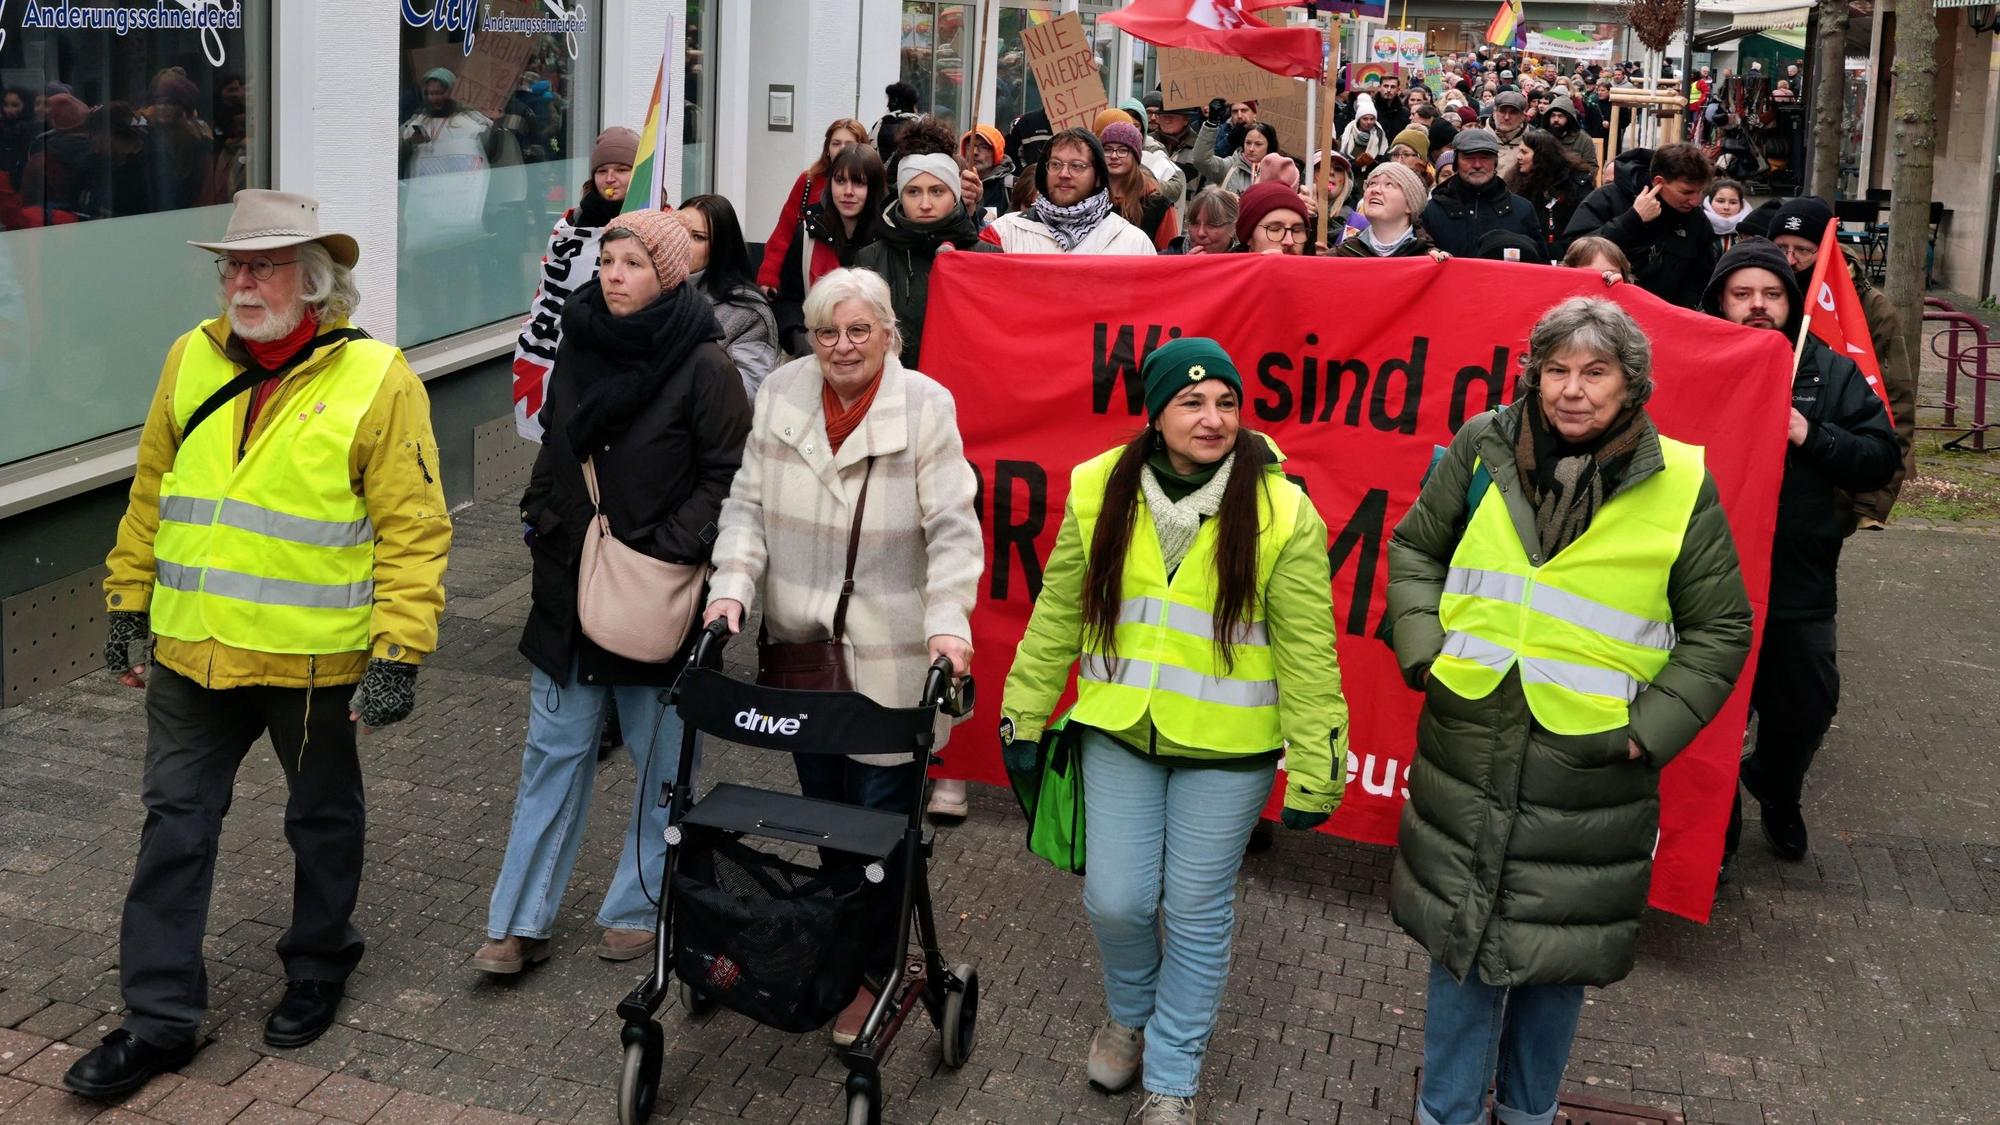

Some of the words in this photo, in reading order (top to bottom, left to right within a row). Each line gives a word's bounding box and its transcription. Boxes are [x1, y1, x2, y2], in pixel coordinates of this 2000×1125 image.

[482, 4, 587, 38] Änderungsschneiderei
[1024, 17, 1073, 60] NIE
[1036, 49, 1098, 91] WIEDER
[1170, 71, 1281, 102] ALTERNATIVE
[1045, 86, 1078, 119] IST
[1253, 333, 1429, 435] sind
